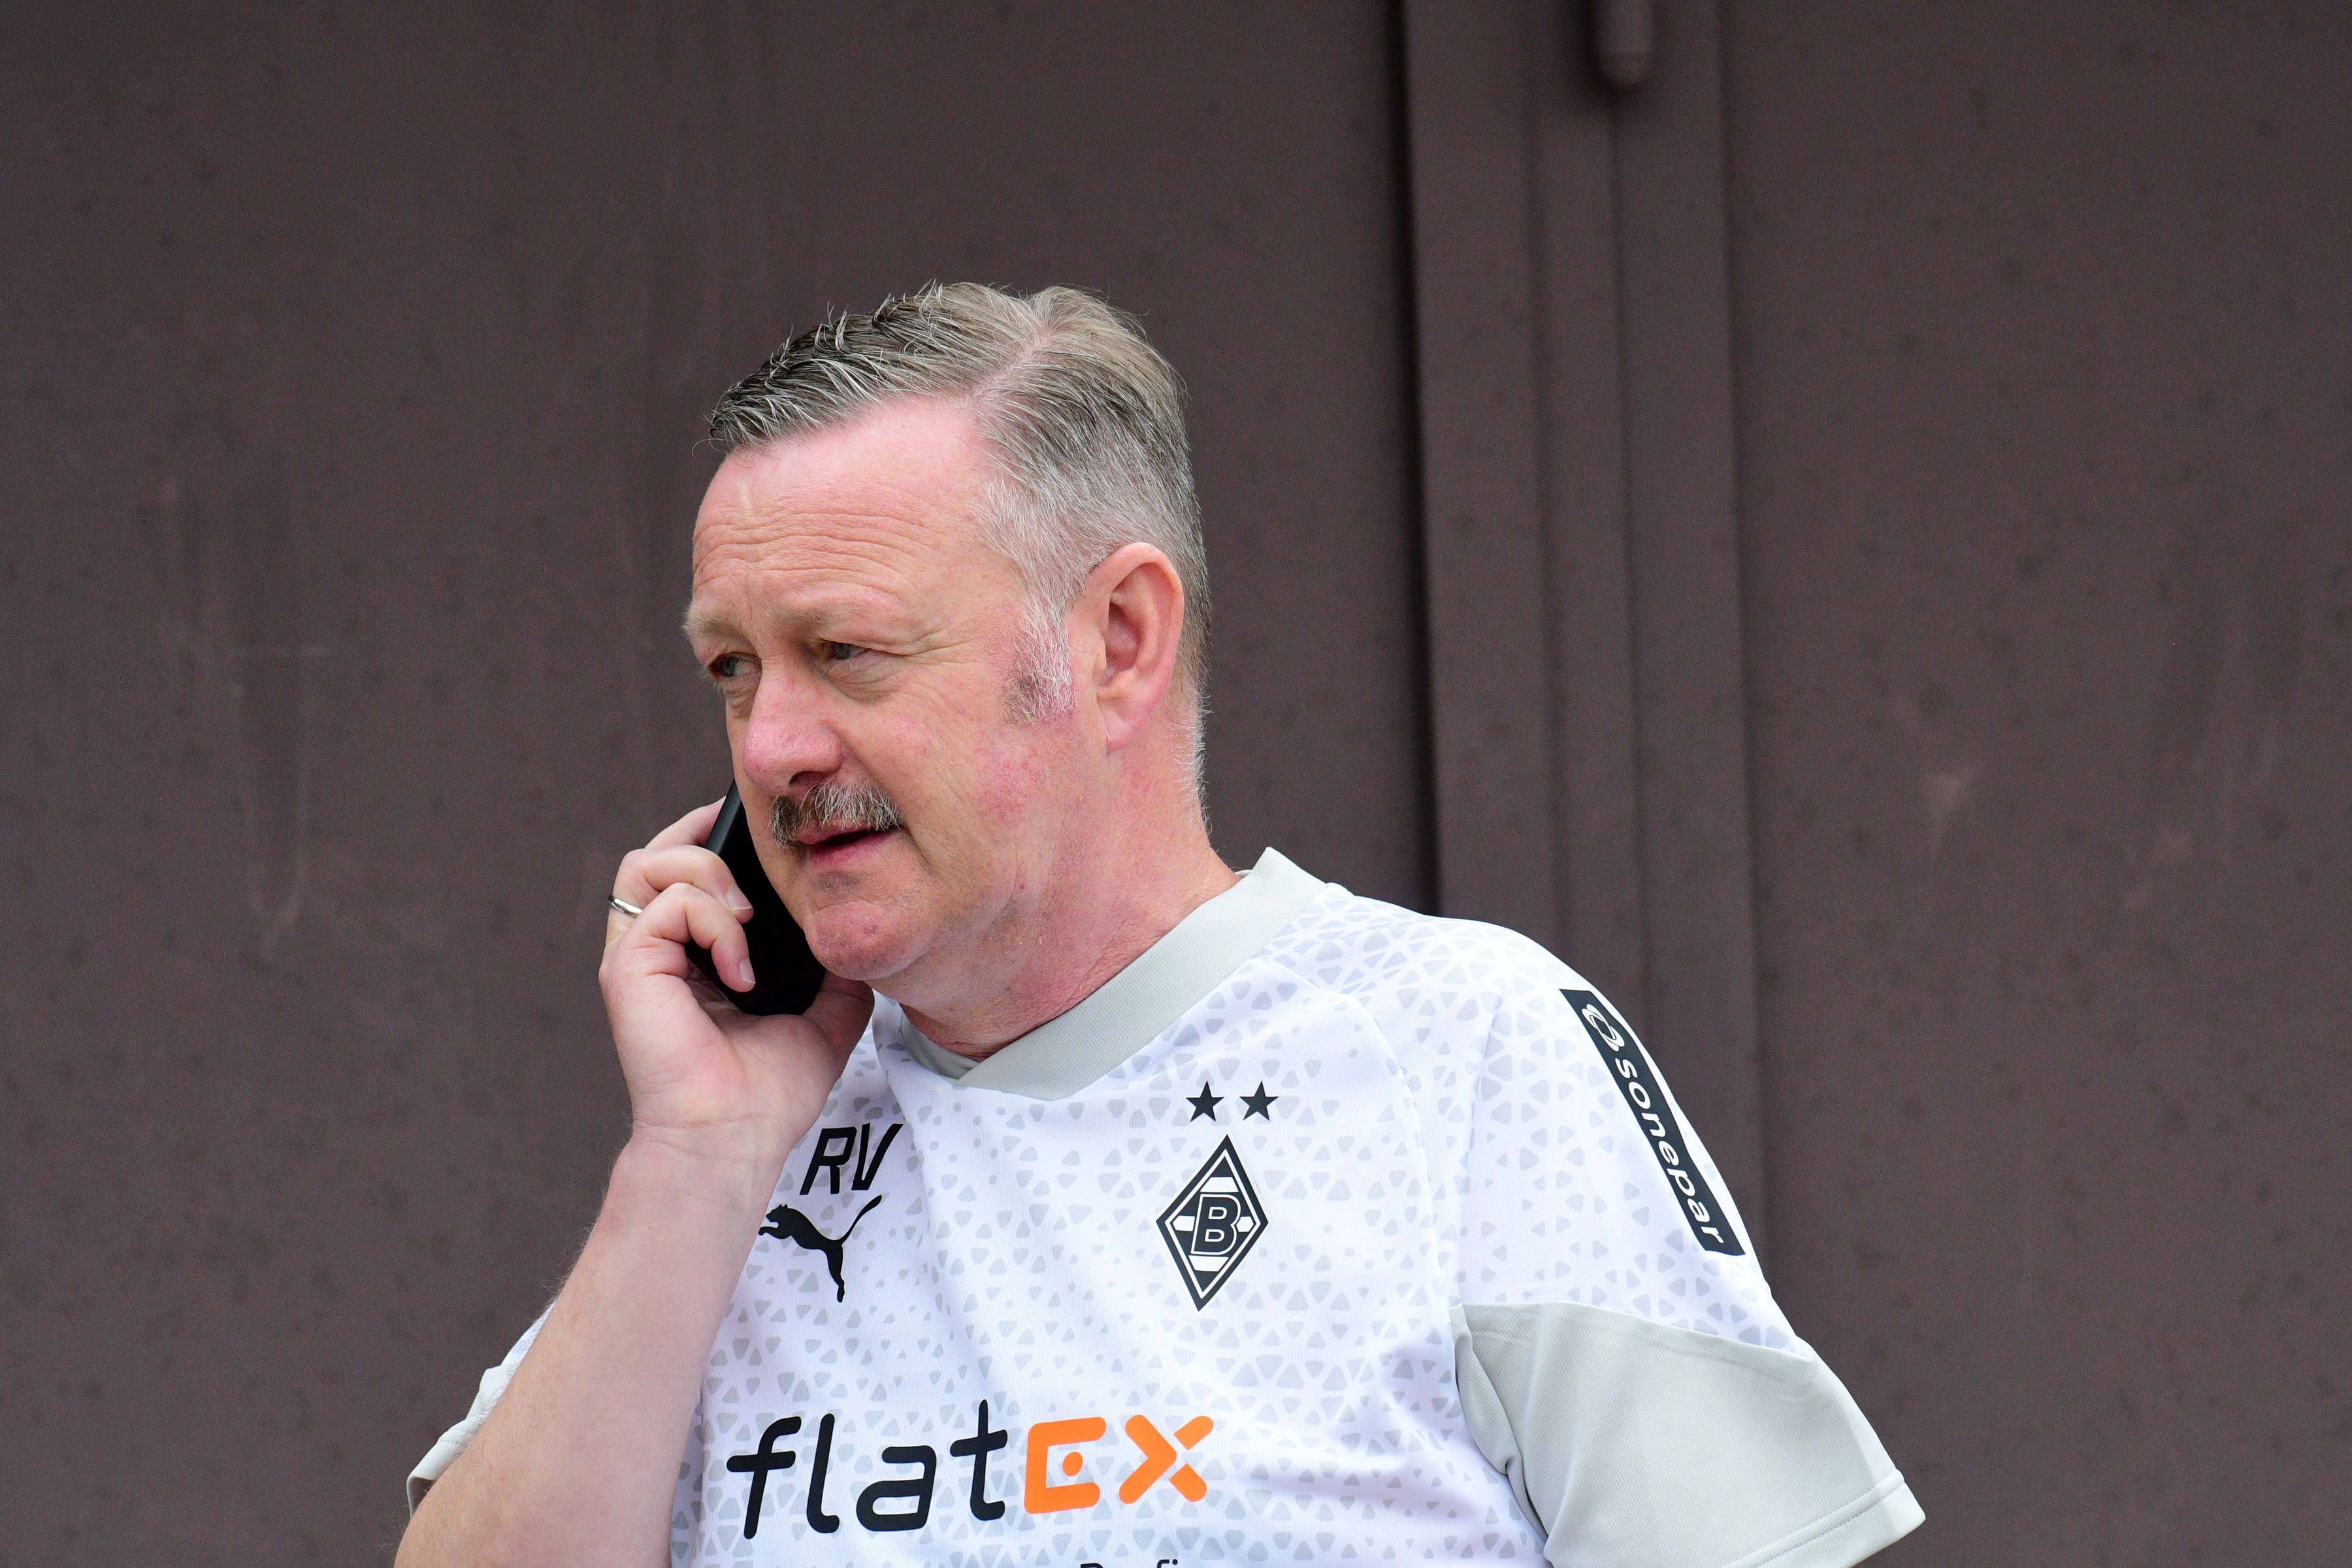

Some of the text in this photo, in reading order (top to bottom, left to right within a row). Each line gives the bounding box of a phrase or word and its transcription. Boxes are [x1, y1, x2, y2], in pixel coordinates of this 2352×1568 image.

[800, 1123, 904, 1195] RV
[1615, 1057, 1724, 1243] sonepar
[1191, 1194, 1241, 1256] B
